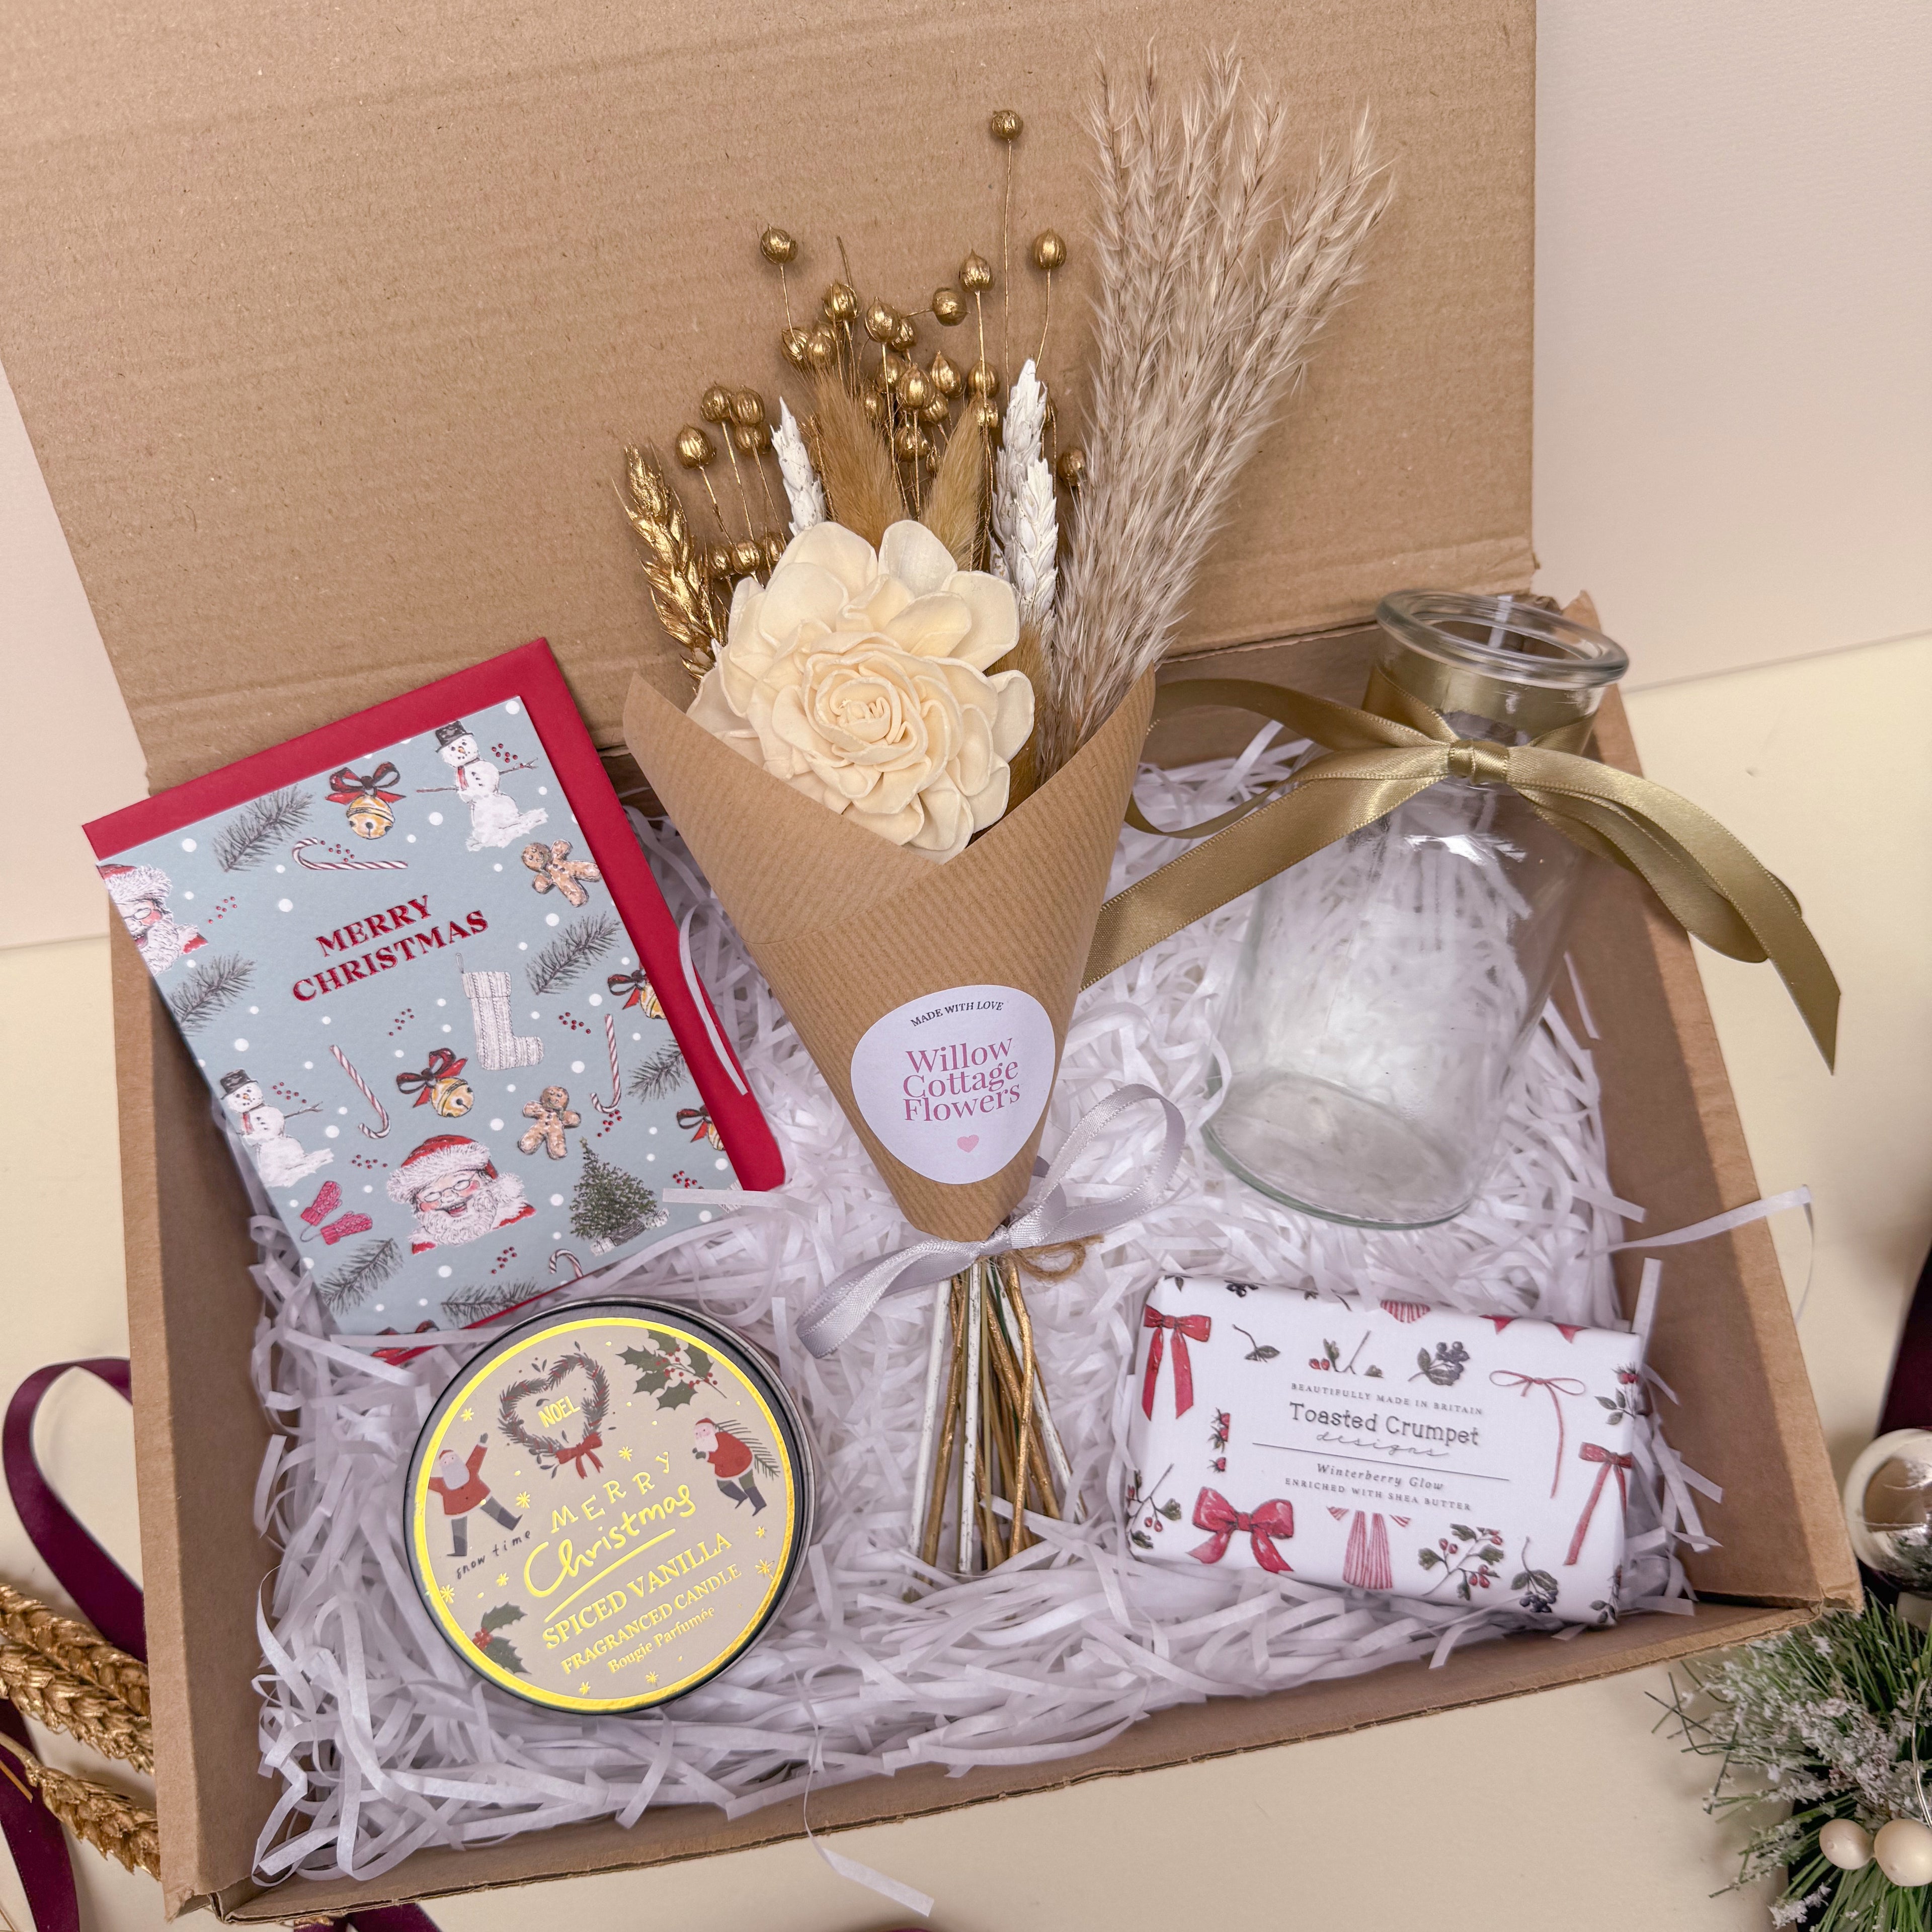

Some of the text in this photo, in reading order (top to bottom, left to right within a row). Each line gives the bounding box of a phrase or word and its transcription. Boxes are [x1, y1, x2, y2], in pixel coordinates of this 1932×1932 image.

[316, 895, 432, 957] MERRY
[293, 910, 489, 1002] CHRISTMAS
[910, 1001, 1004, 1026] MADE WITH LOVE
[905, 1038, 1013, 1073] Willow
[903, 1062, 1018, 1098] Cottage
[903, 1084, 1020, 1121] Flowers
[538, 1396, 580, 1427] NOEL
[1291, 1383, 1483, 1415] BEAUTIFULLY MADE IN BRITAIN
[1290, 1402, 1479, 1445] Toasted Crumpet
[1316, 1431, 1449, 1456] designs
[1285, 1478, 1471, 1510] ENRICHED WITH SHEA BUTTER
[1317, 1463, 1444, 1490] Winterberry Glow
[457, 1531, 530, 1579] snow time
[523, 1484, 696, 1597] Christmas
[542, 1533, 733, 1649] SPICED VANILLA
[560, 1563, 742, 1674] FRAGRANCED CANDLE
[607, 1605, 715, 1673] Bougie Parfumée
